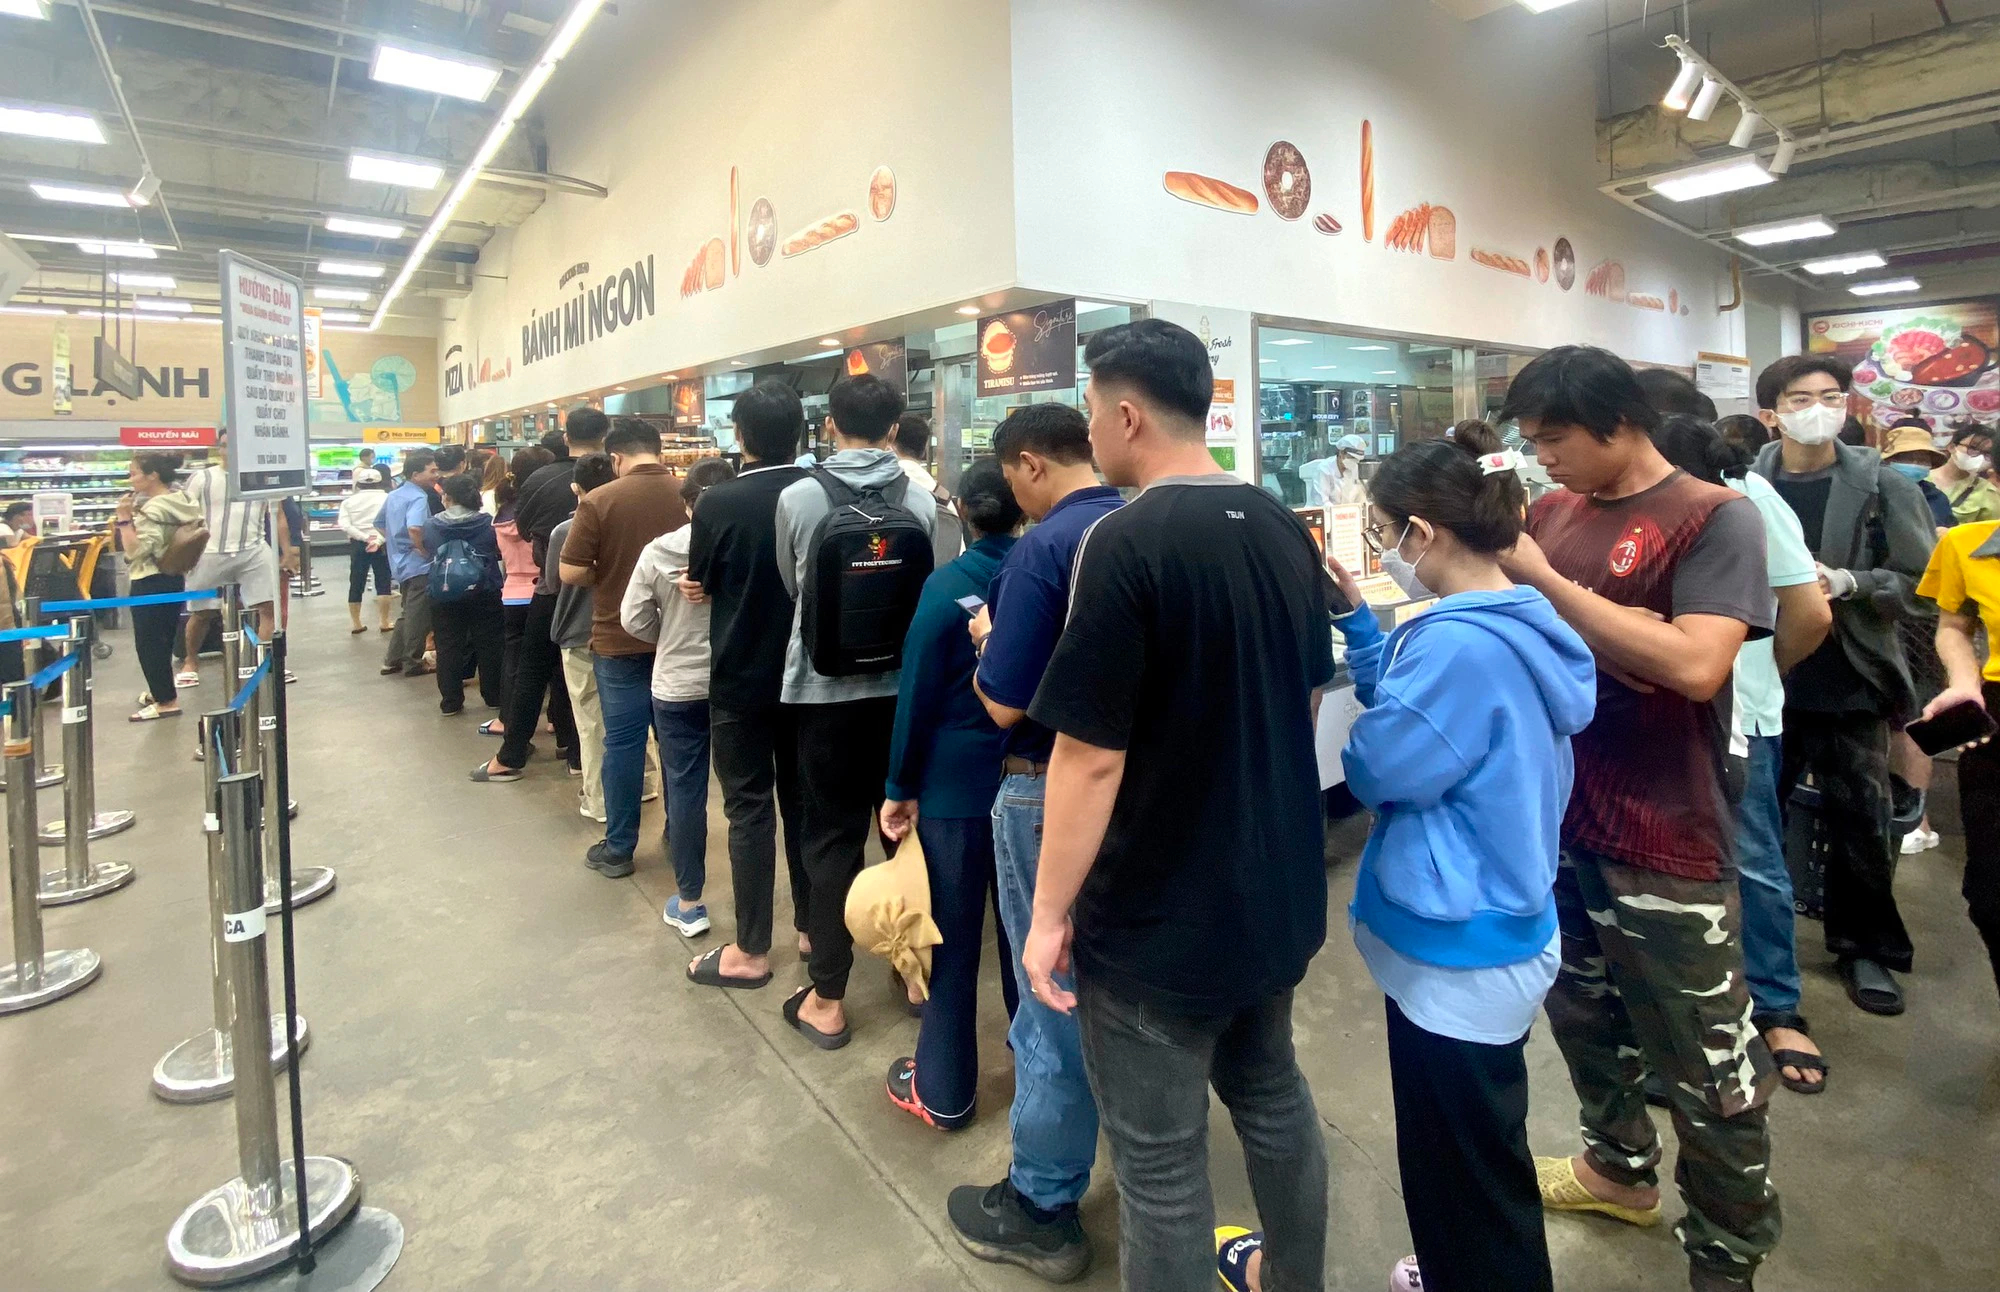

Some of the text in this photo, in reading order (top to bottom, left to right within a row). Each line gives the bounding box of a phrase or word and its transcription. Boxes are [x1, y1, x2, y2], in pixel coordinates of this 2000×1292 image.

[522, 254, 654, 366] BÁNH MÌ NGON
[445, 362, 463, 398] PIZZA
[984, 376, 1015, 389] TIRAMISU
[138, 430, 199, 438] KHUYẾN MÃI
